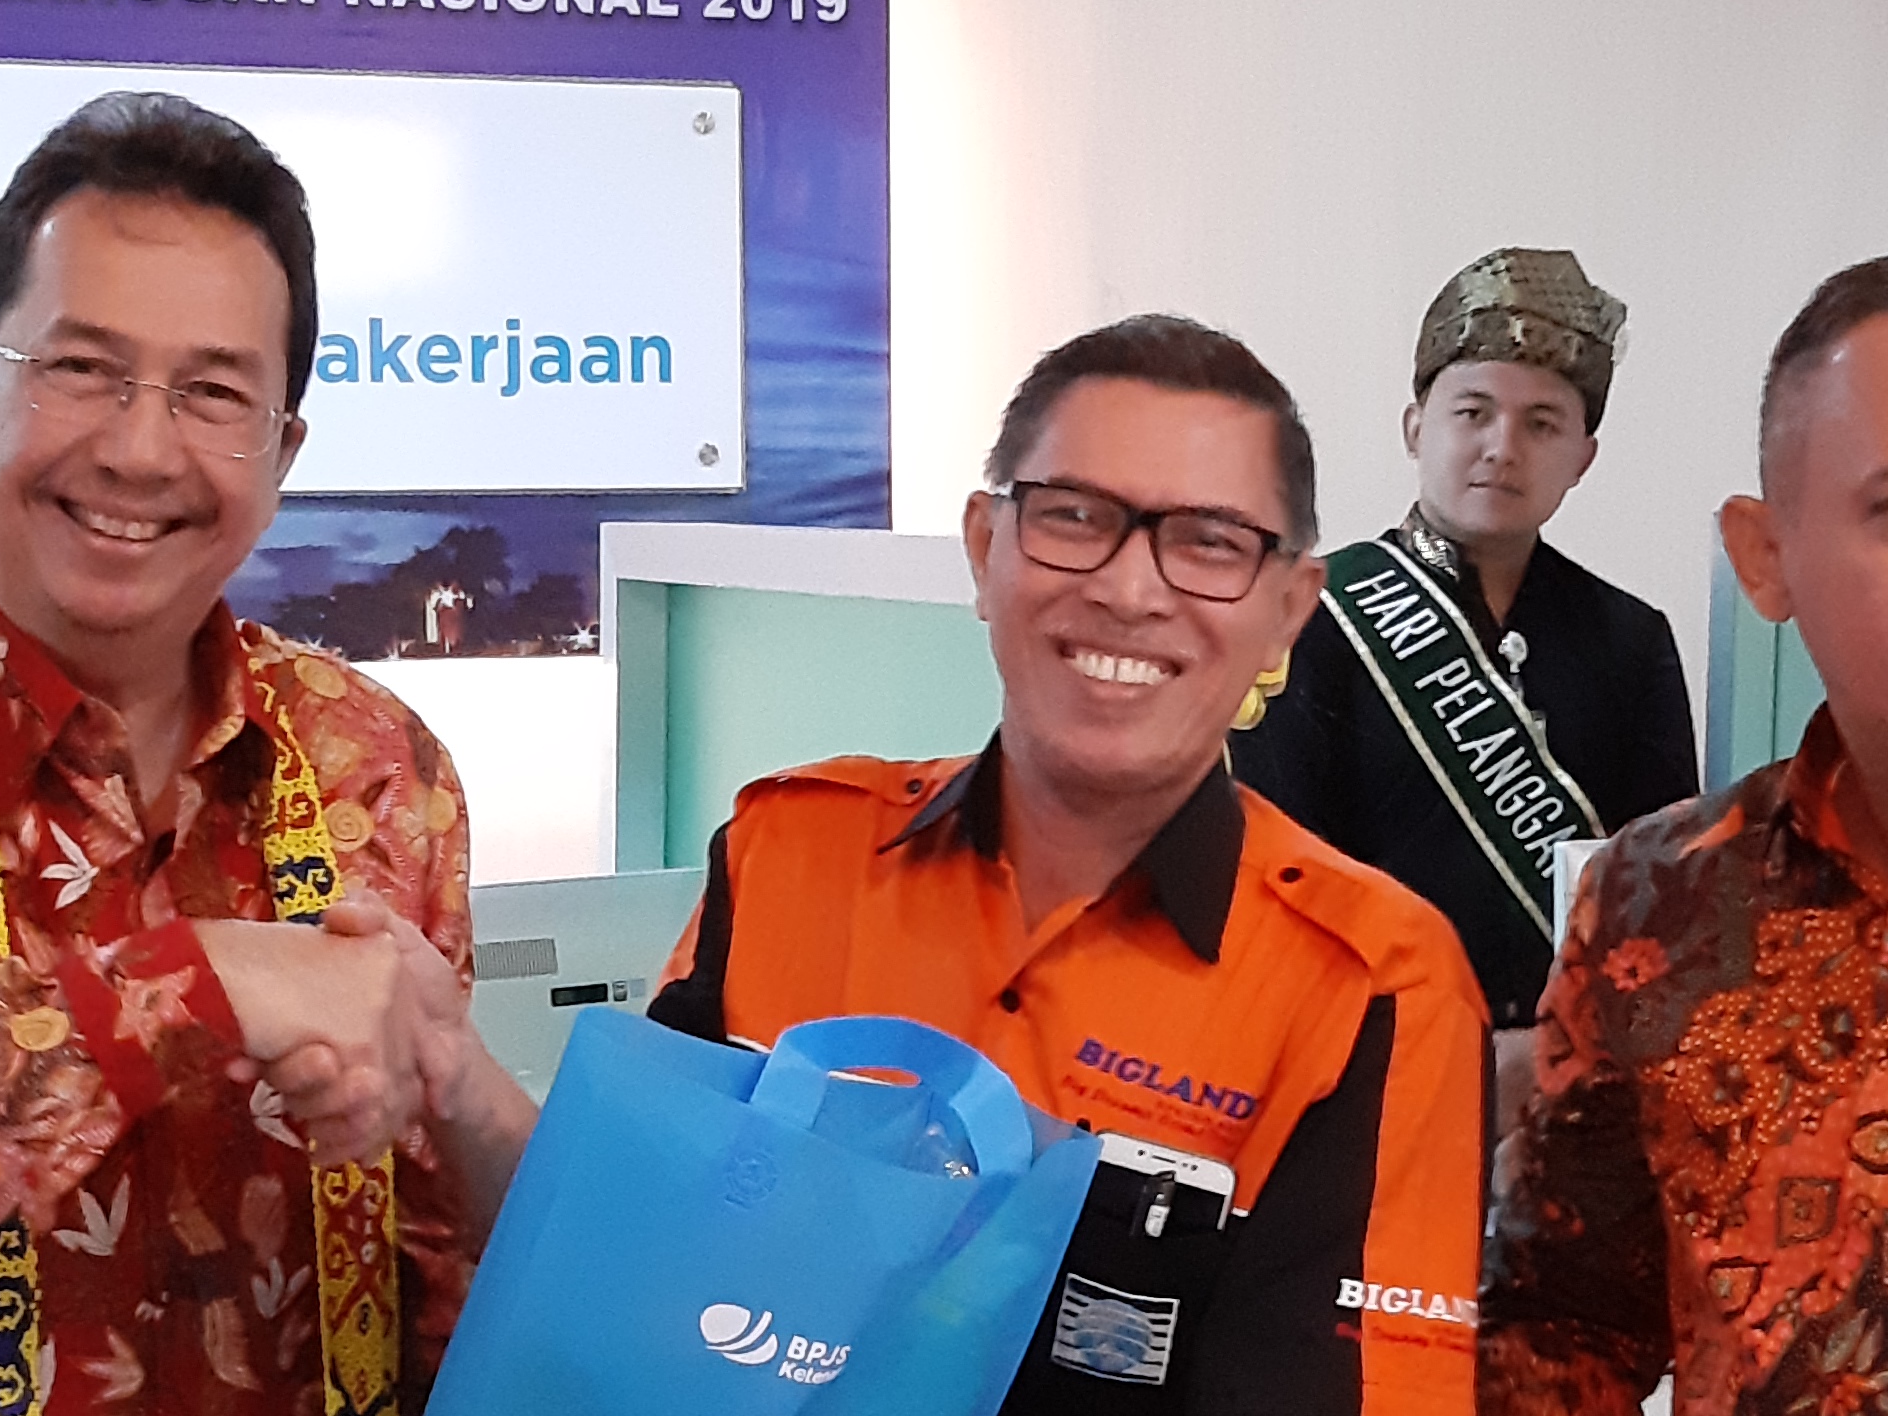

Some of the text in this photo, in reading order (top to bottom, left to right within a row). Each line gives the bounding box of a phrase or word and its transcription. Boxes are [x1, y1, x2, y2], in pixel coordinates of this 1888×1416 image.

[1343, 568, 1579, 880] HARI PELANGGA
[1075, 1038, 1259, 1120] BIGLAND
[786, 1334, 852, 1367] BPJS
